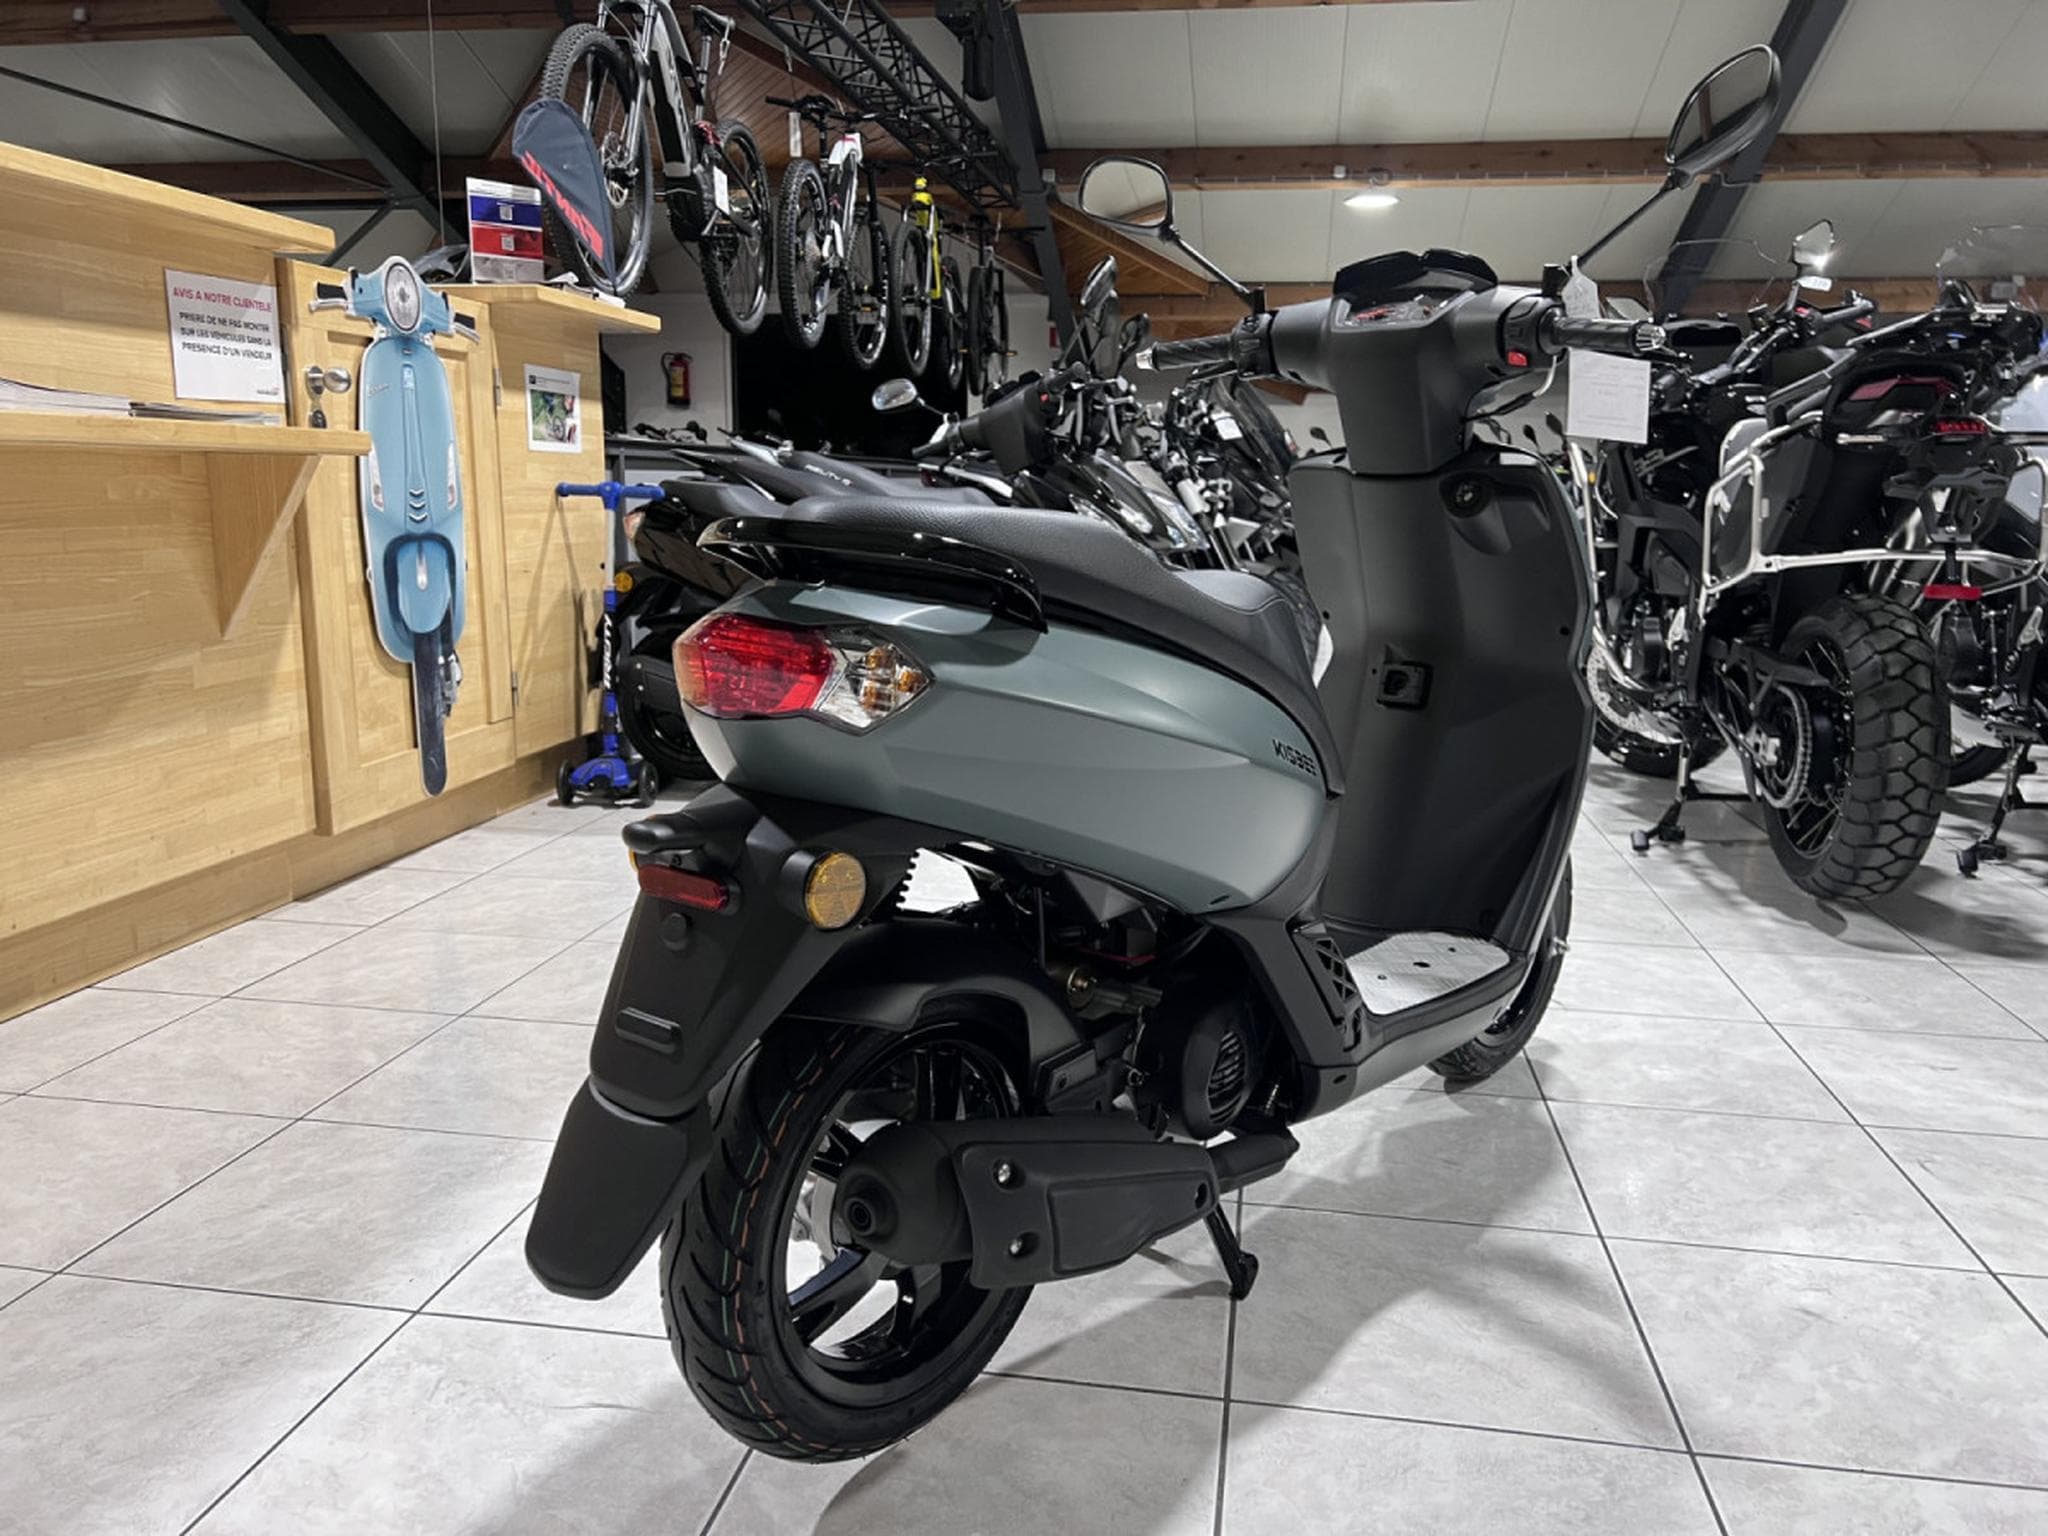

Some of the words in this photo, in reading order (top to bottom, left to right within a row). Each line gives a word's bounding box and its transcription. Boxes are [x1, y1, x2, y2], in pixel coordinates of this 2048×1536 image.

[173, 286, 193, 300] AVIS
[195, 290, 202, 300] A
[204, 291, 231, 305] NOTRE
[206, 314, 216, 325] DE
